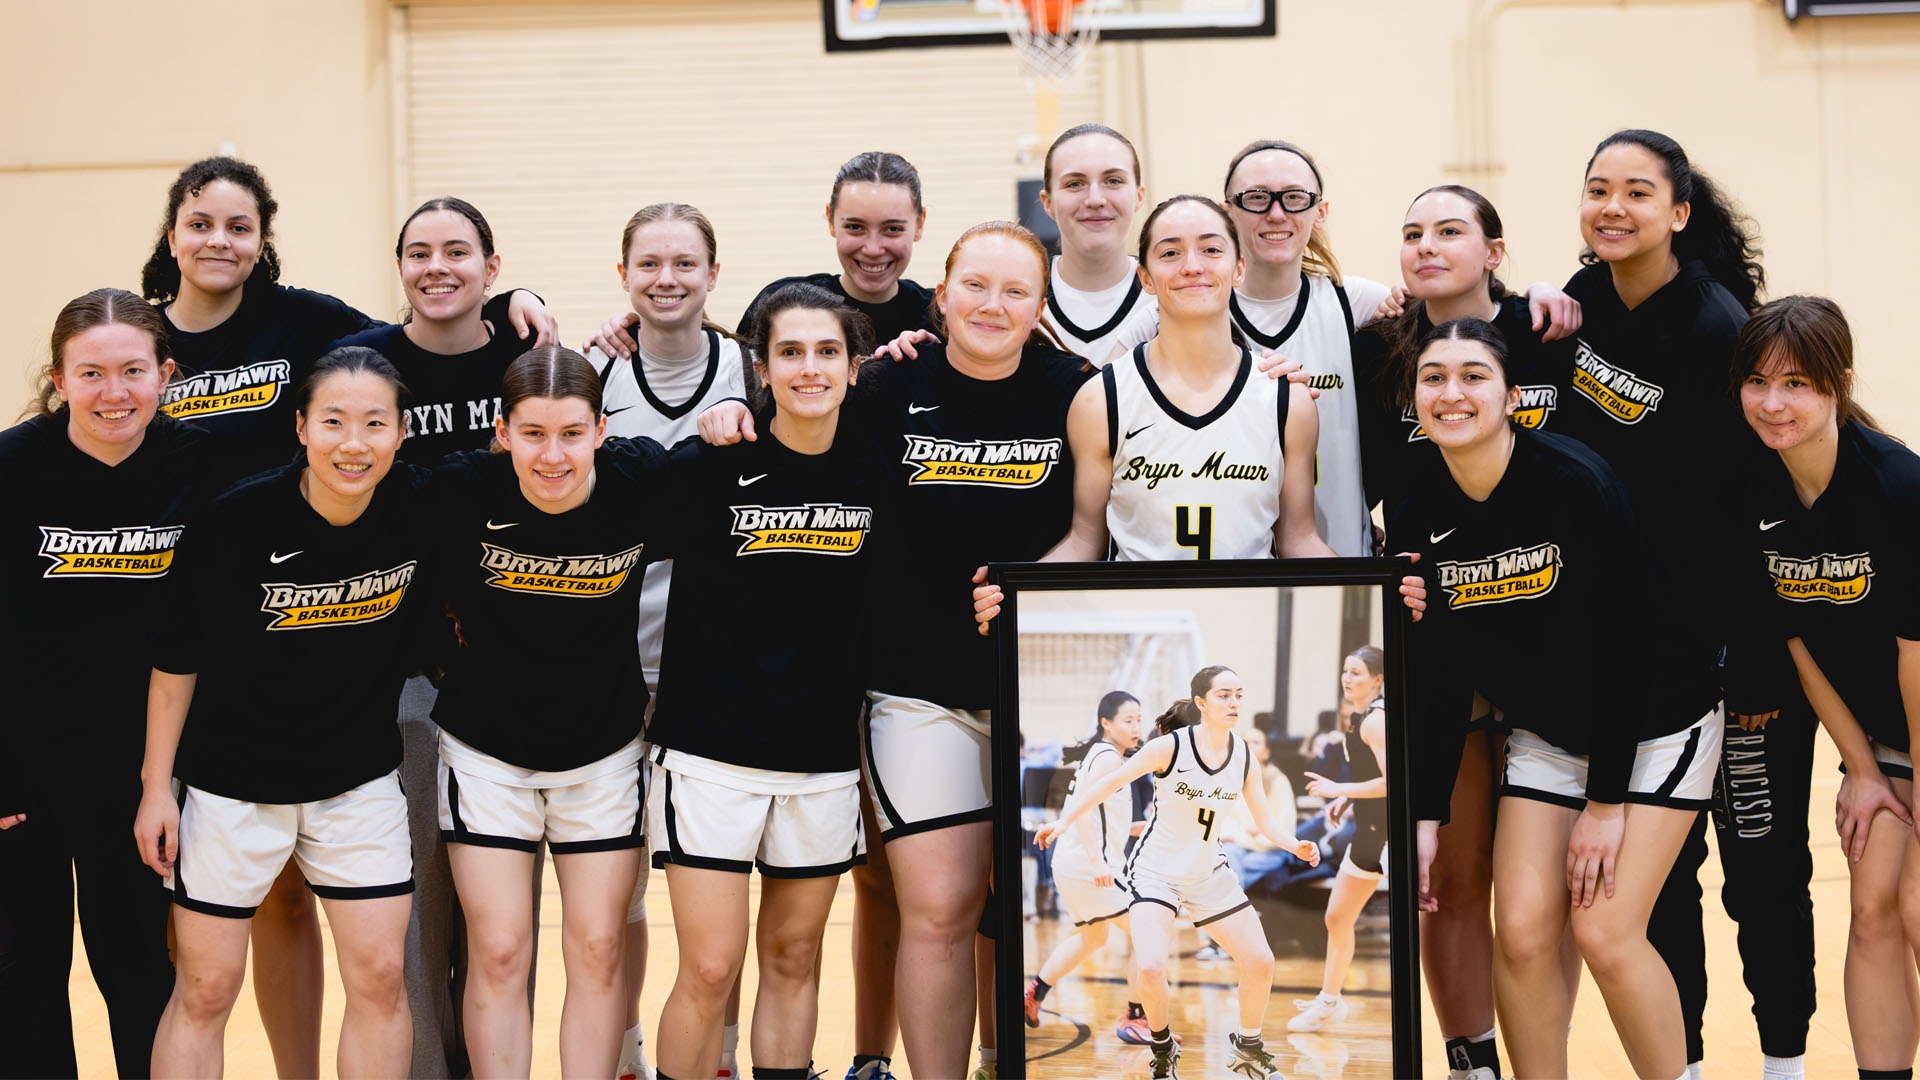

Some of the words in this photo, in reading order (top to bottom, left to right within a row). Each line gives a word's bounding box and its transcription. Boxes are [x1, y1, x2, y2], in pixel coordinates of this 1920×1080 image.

[163, 378, 210, 404] RYN
[213, 363, 286, 395] MAWR
[1575, 344, 1615, 385] BRYN
[1609, 370, 1661, 406] MAWR
[172, 392, 266, 414] BASKETBALL
[1578, 375, 1633, 417] BASKETBALL
[403, 403, 453, 440] RYN
[467, 397, 502, 430] MA
[909, 439, 981, 464] BRYN
[982, 442, 1060, 464] MAWR
[935, 465, 1033, 479] BASKETBALL
[1121, 455, 1184, 490] Bryn
[1191, 450, 1270, 482] Mawr
[738, 509, 810, 530] BRYN
[810, 507, 871, 529] MAWR
[46, 532, 118, 553] BRYN
[765, 533, 854, 546] BASKETBALL
[1174, 504, 1214, 560] 4
[73, 558, 164, 569] BASKETBALL
[486, 548, 563, 575] BRYN
[563, 548, 641, 576] MAWR
[268, 586, 345, 608] BRYN
[345, 565, 415, 602] MAWR
[511, 576, 614, 591] BASKETBALL
[1441, 563, 1493, 587] BRYN
[1465, 578, 1544, 598] BASKETBALL
[297, 599, 392, 621] BASKETBALL
[1174, 781, 1204, 800] Bryn
[1726, 724, 1772, 838] RANCISCO
[1197, 807, 1216, 842] 4
